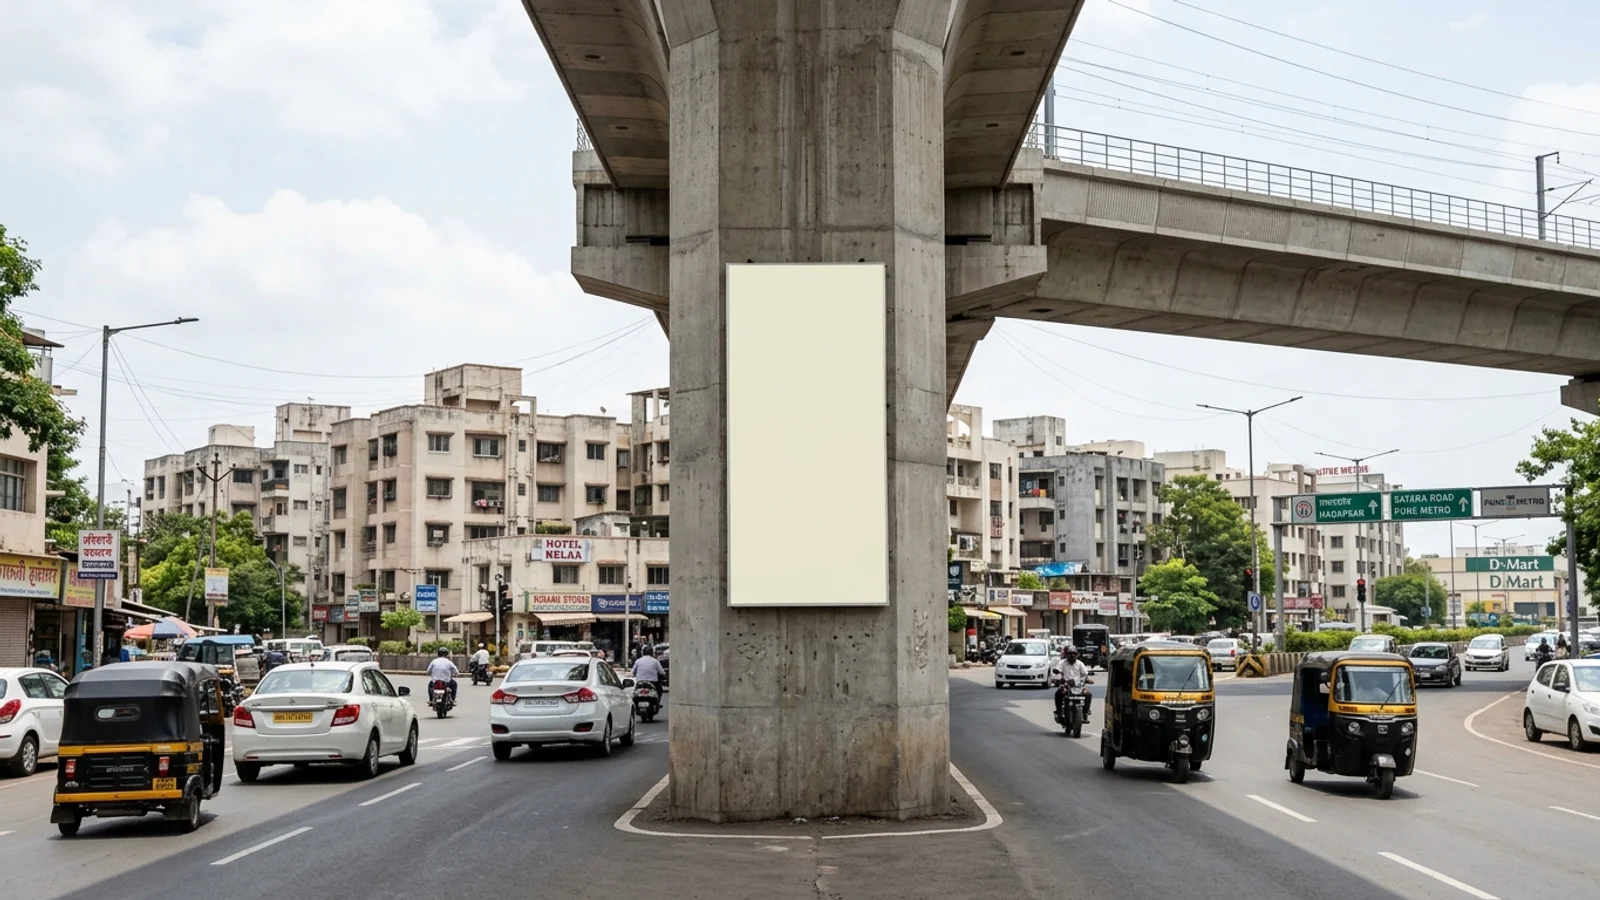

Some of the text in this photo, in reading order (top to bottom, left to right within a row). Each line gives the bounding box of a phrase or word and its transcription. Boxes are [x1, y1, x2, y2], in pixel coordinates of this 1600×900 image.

[1394, 493, 1455, 504] SATARA ROAD
[1420, 505, 1451, 515] METRO
[545, 550, 582, 559] NELAA
